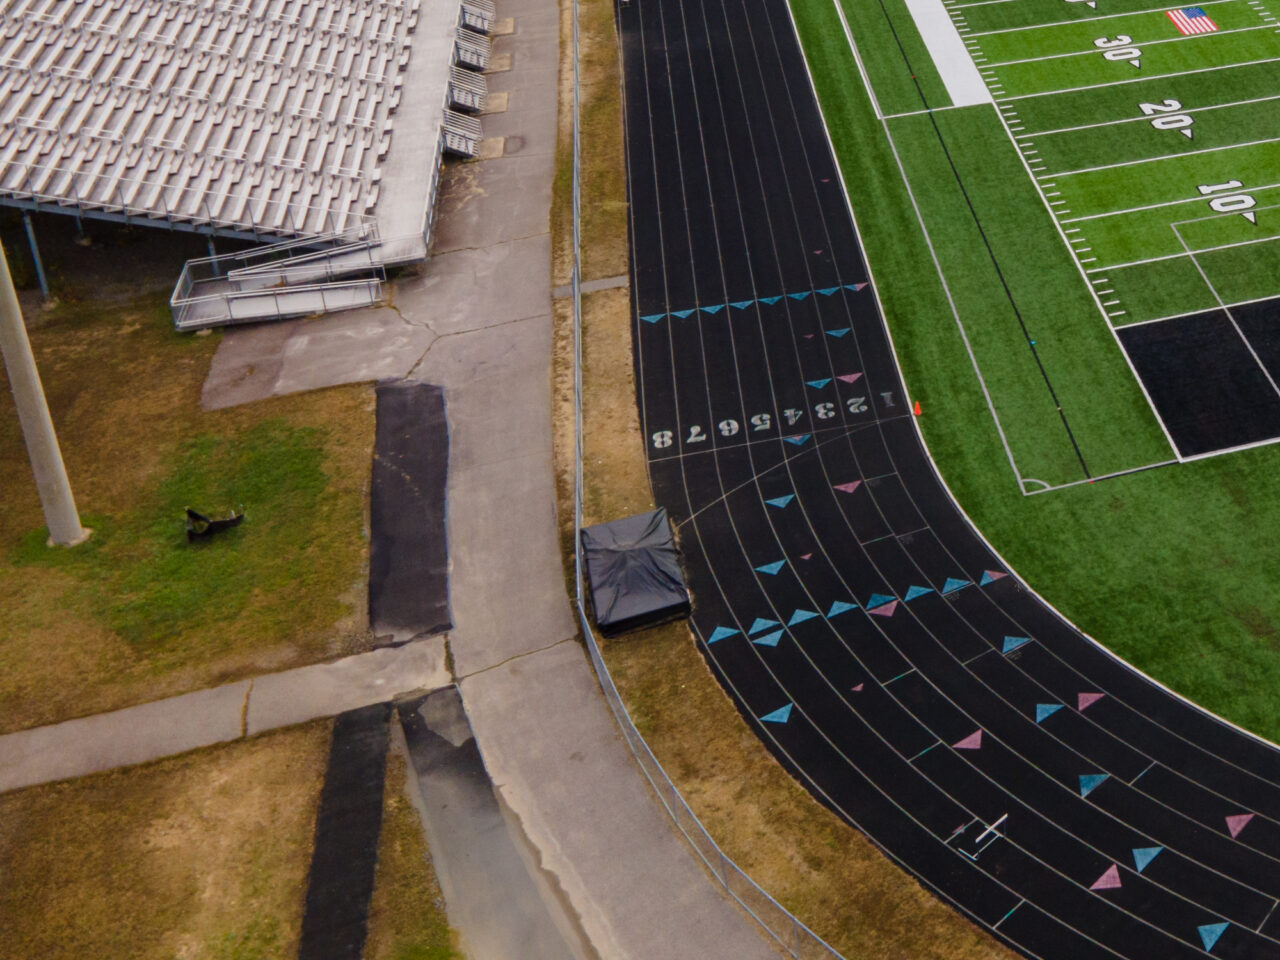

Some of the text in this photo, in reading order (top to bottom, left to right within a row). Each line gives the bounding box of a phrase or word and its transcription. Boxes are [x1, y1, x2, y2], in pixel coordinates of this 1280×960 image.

[1093, 34, 1143, 61] 30
[1137, 99, 1195, 130] 20
[1197, 180, 1258, 213] 10
[652, 391, 896, 448] 1 2 3 4 5 6 7 8
